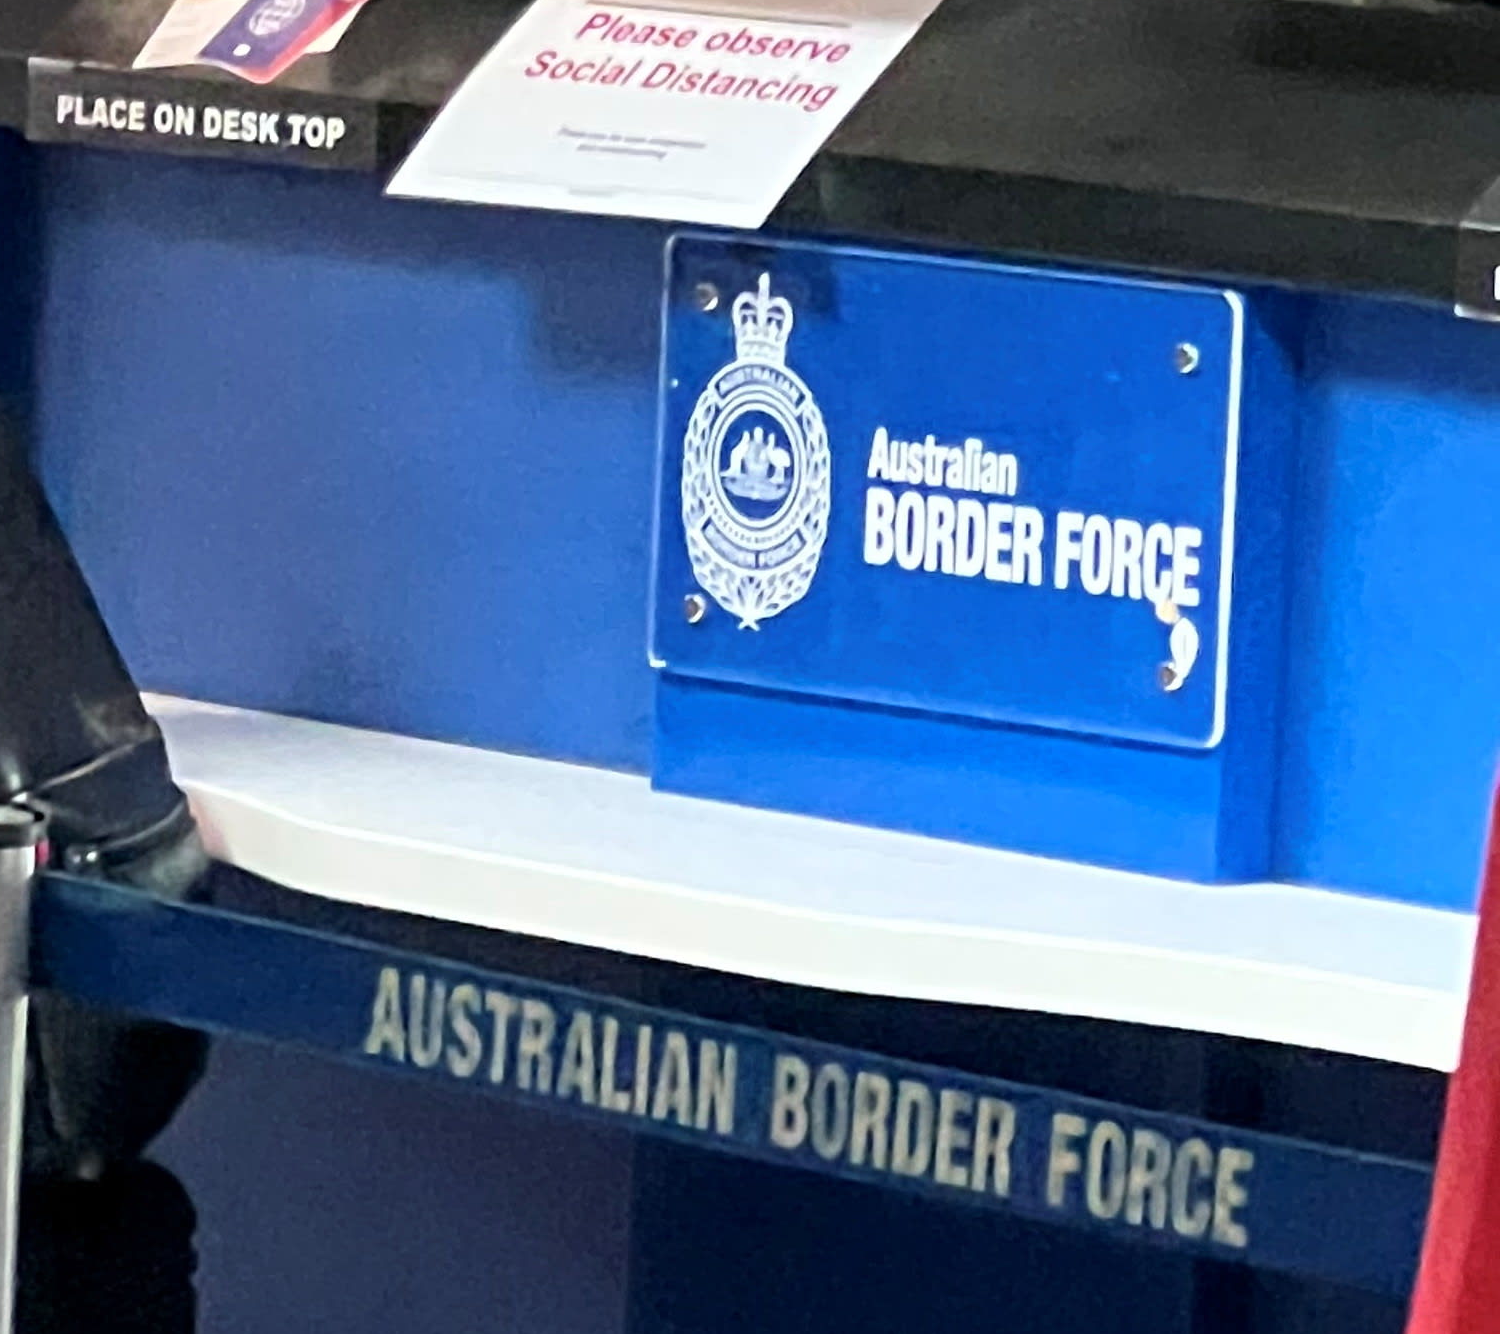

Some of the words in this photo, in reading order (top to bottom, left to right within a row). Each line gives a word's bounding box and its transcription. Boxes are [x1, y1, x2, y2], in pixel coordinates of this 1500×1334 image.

[575, 12, 698, 50] Please
[704, 27, 852, 64] observe
[523, 50, 644, 87] Social
[640, 61, 838, 113] Distancing
[56, 94, 145, 132] PLACE
[153, 101, 194, 136] ON
[203, 106, 279, 144] DESK
[286, 113, 346, 149] TOP
[866, 425, 1019, 497] Australian
[862, 485, 1045, 587] BORDER
[1053, 510, 1203, 608] FORCE
[363, 966, 738, 1136] AUSTRALIAN
[770, 1053, 1016, 1197] BORDER
[1046, 1111, 1256, 1249] FORCE
